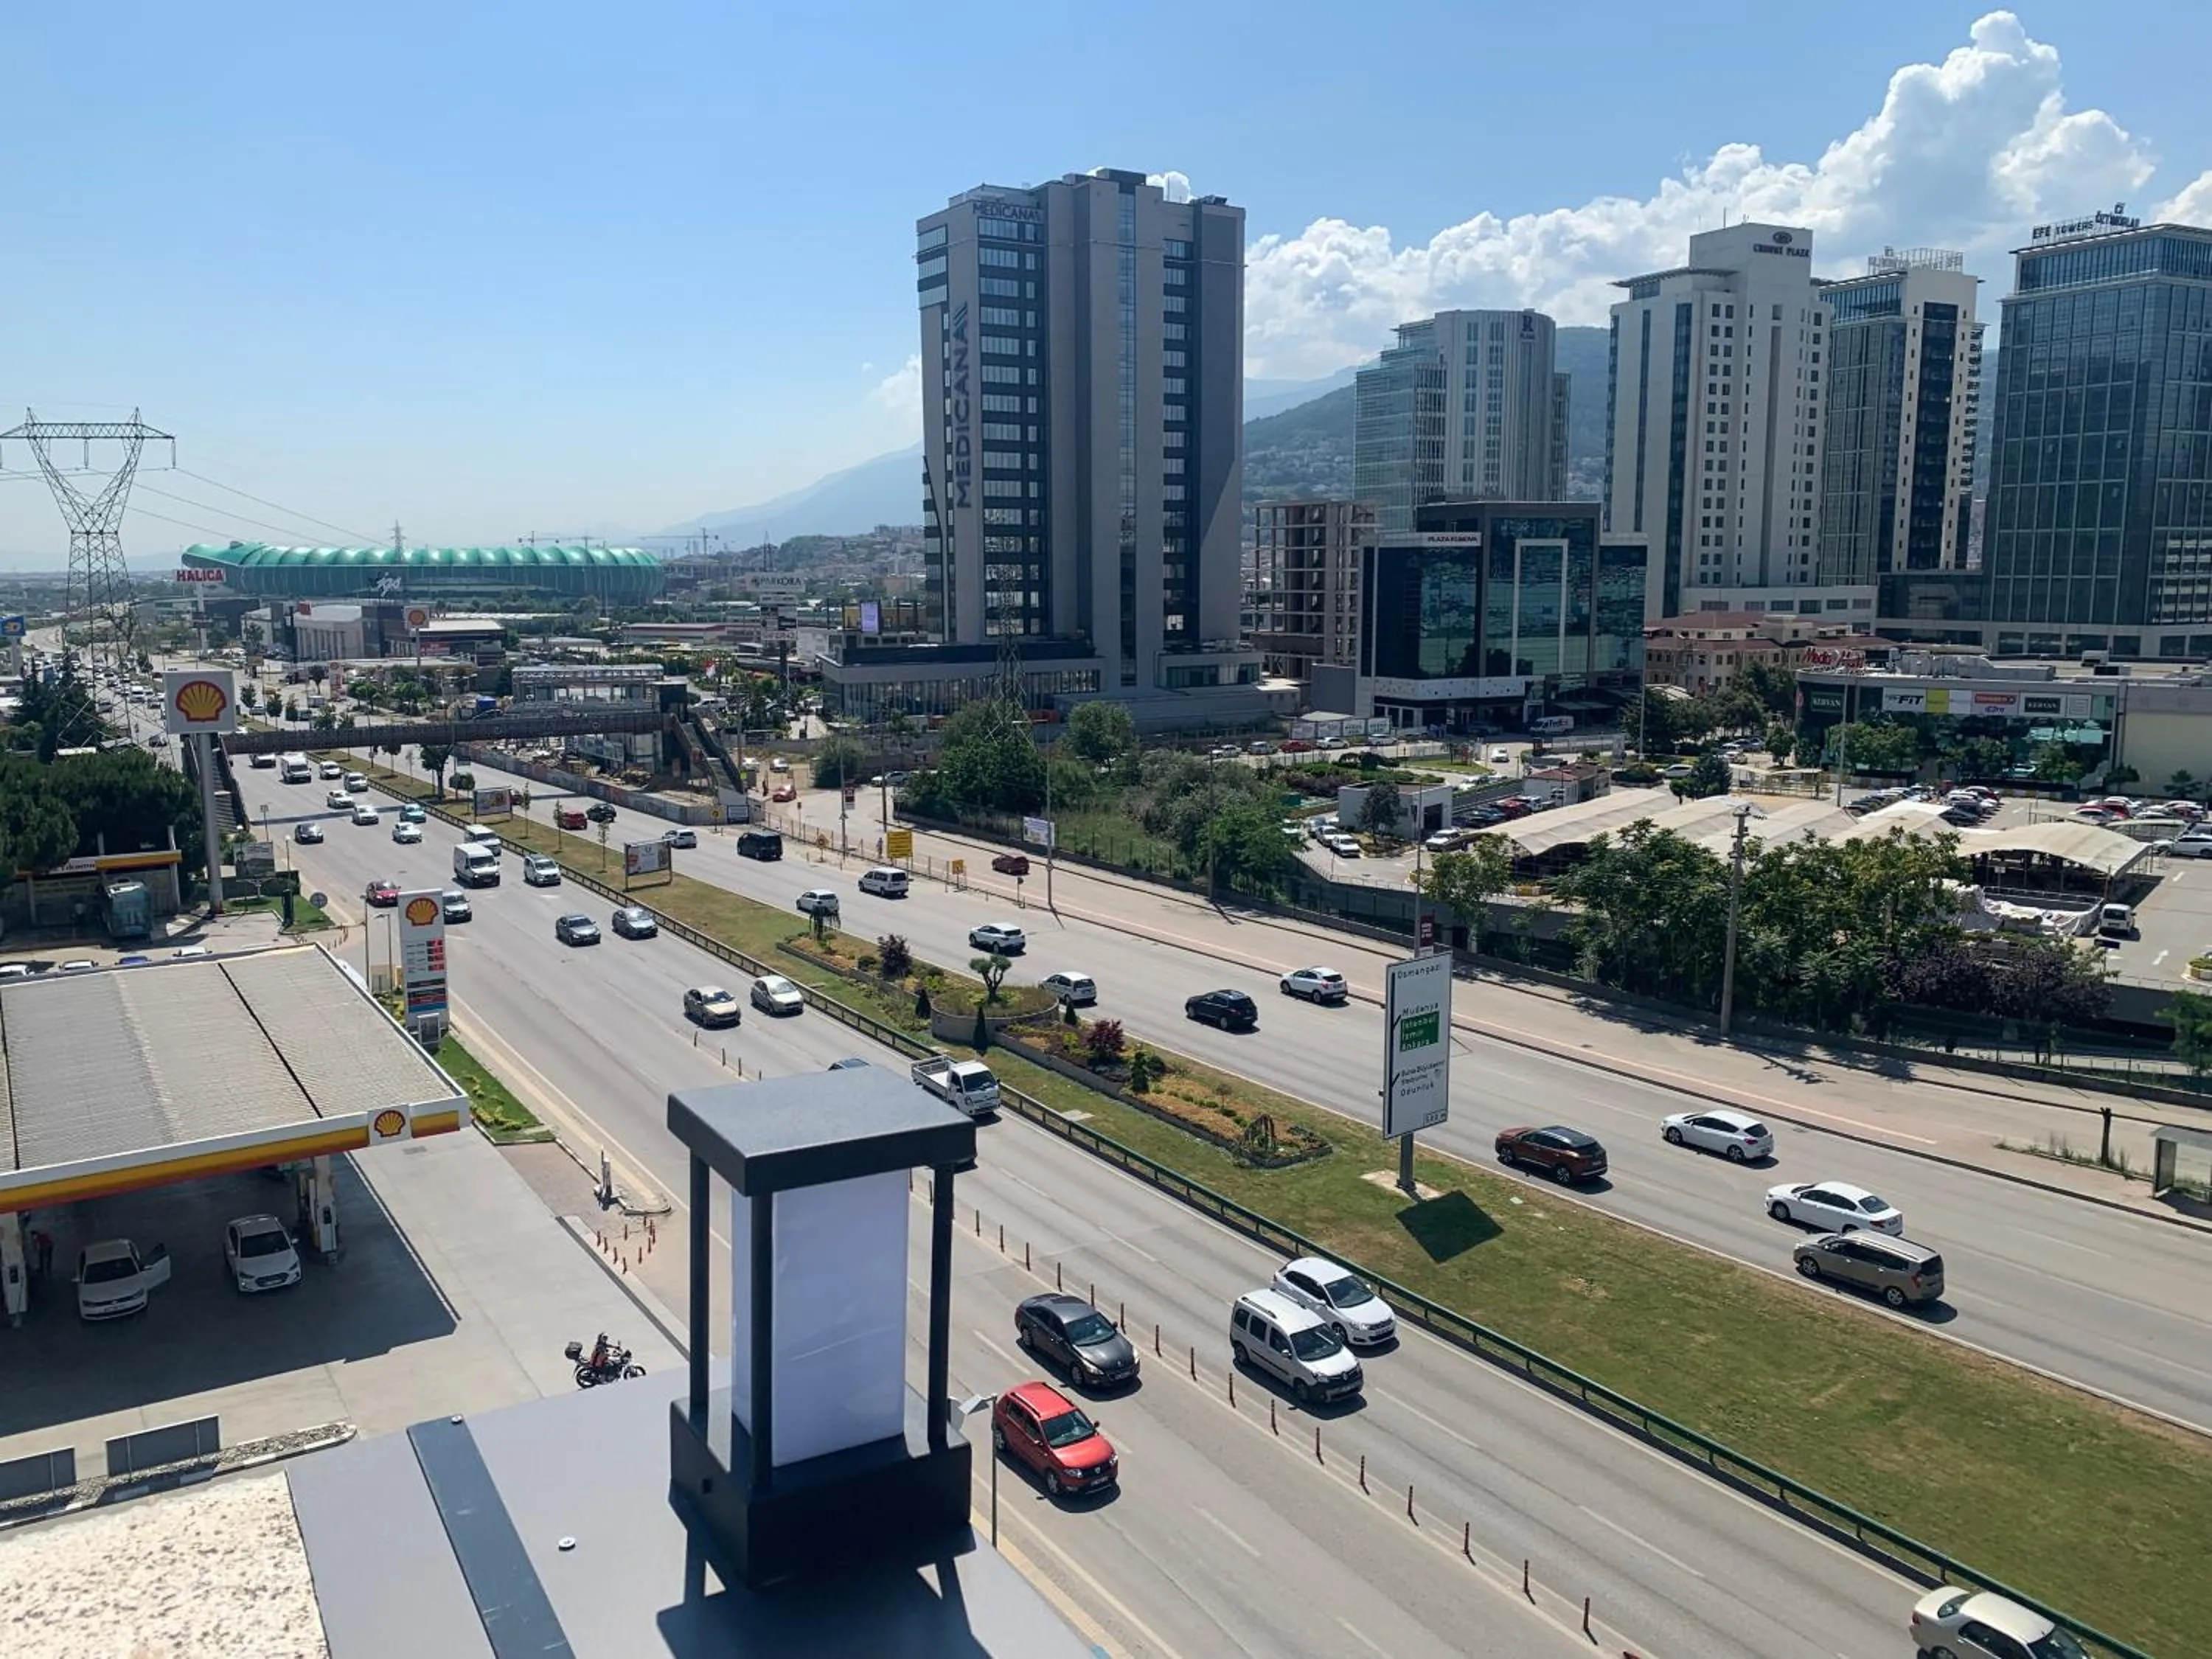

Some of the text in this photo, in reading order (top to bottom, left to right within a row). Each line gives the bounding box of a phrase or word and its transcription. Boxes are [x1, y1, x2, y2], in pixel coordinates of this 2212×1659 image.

[973, 202, 1037, 220] MEDICANA
[2032, 220, 2094, 239] EFE TOWERS
[953, 317, 972, 509] MEDICANA
